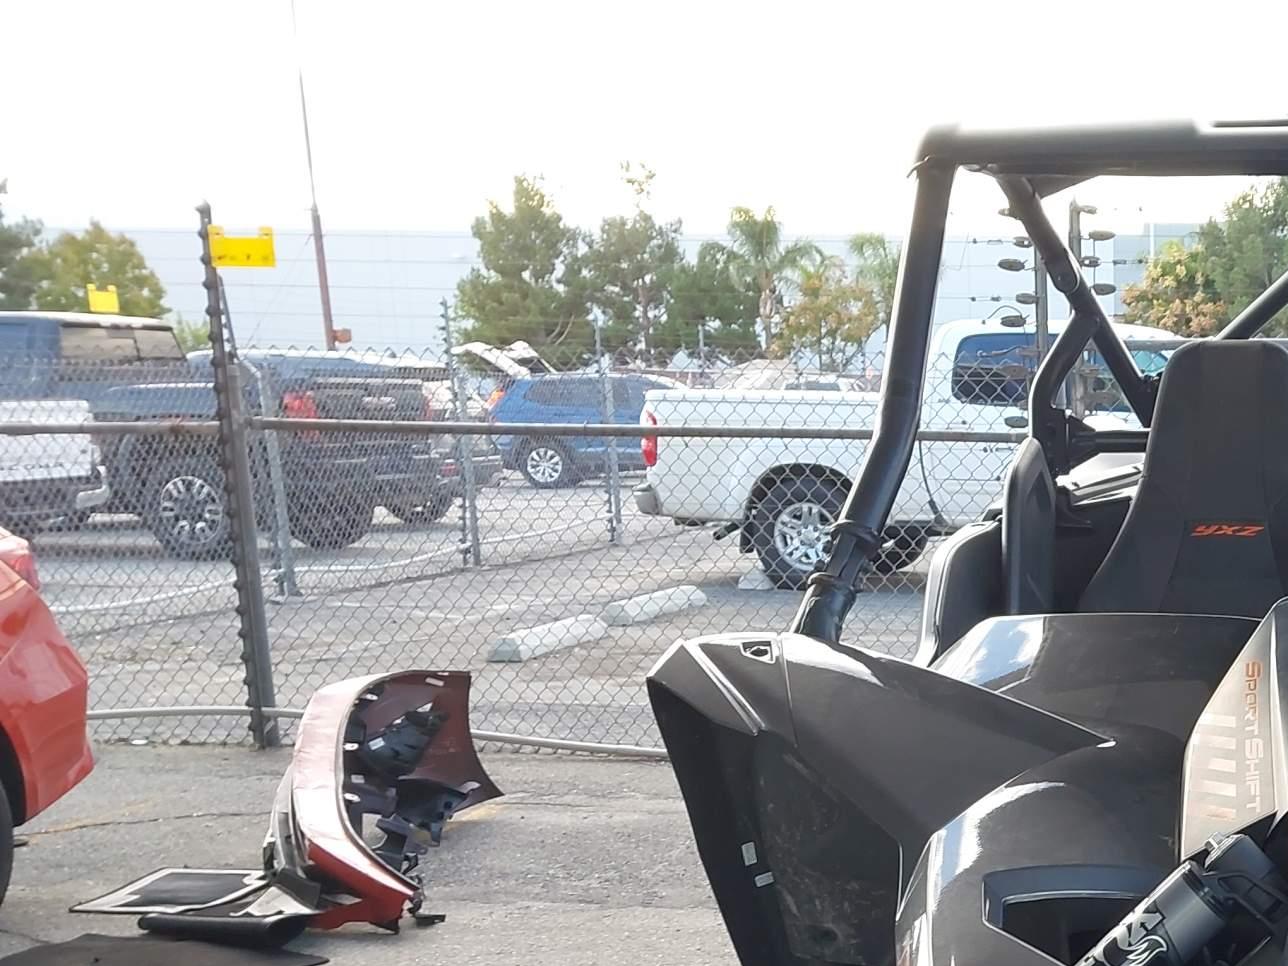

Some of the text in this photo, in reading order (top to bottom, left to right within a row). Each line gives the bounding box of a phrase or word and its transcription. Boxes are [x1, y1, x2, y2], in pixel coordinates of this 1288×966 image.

[1190, 524, 1265, 536] YXZ
[1243, 660, 1265, 813] SPORT SHIFT
